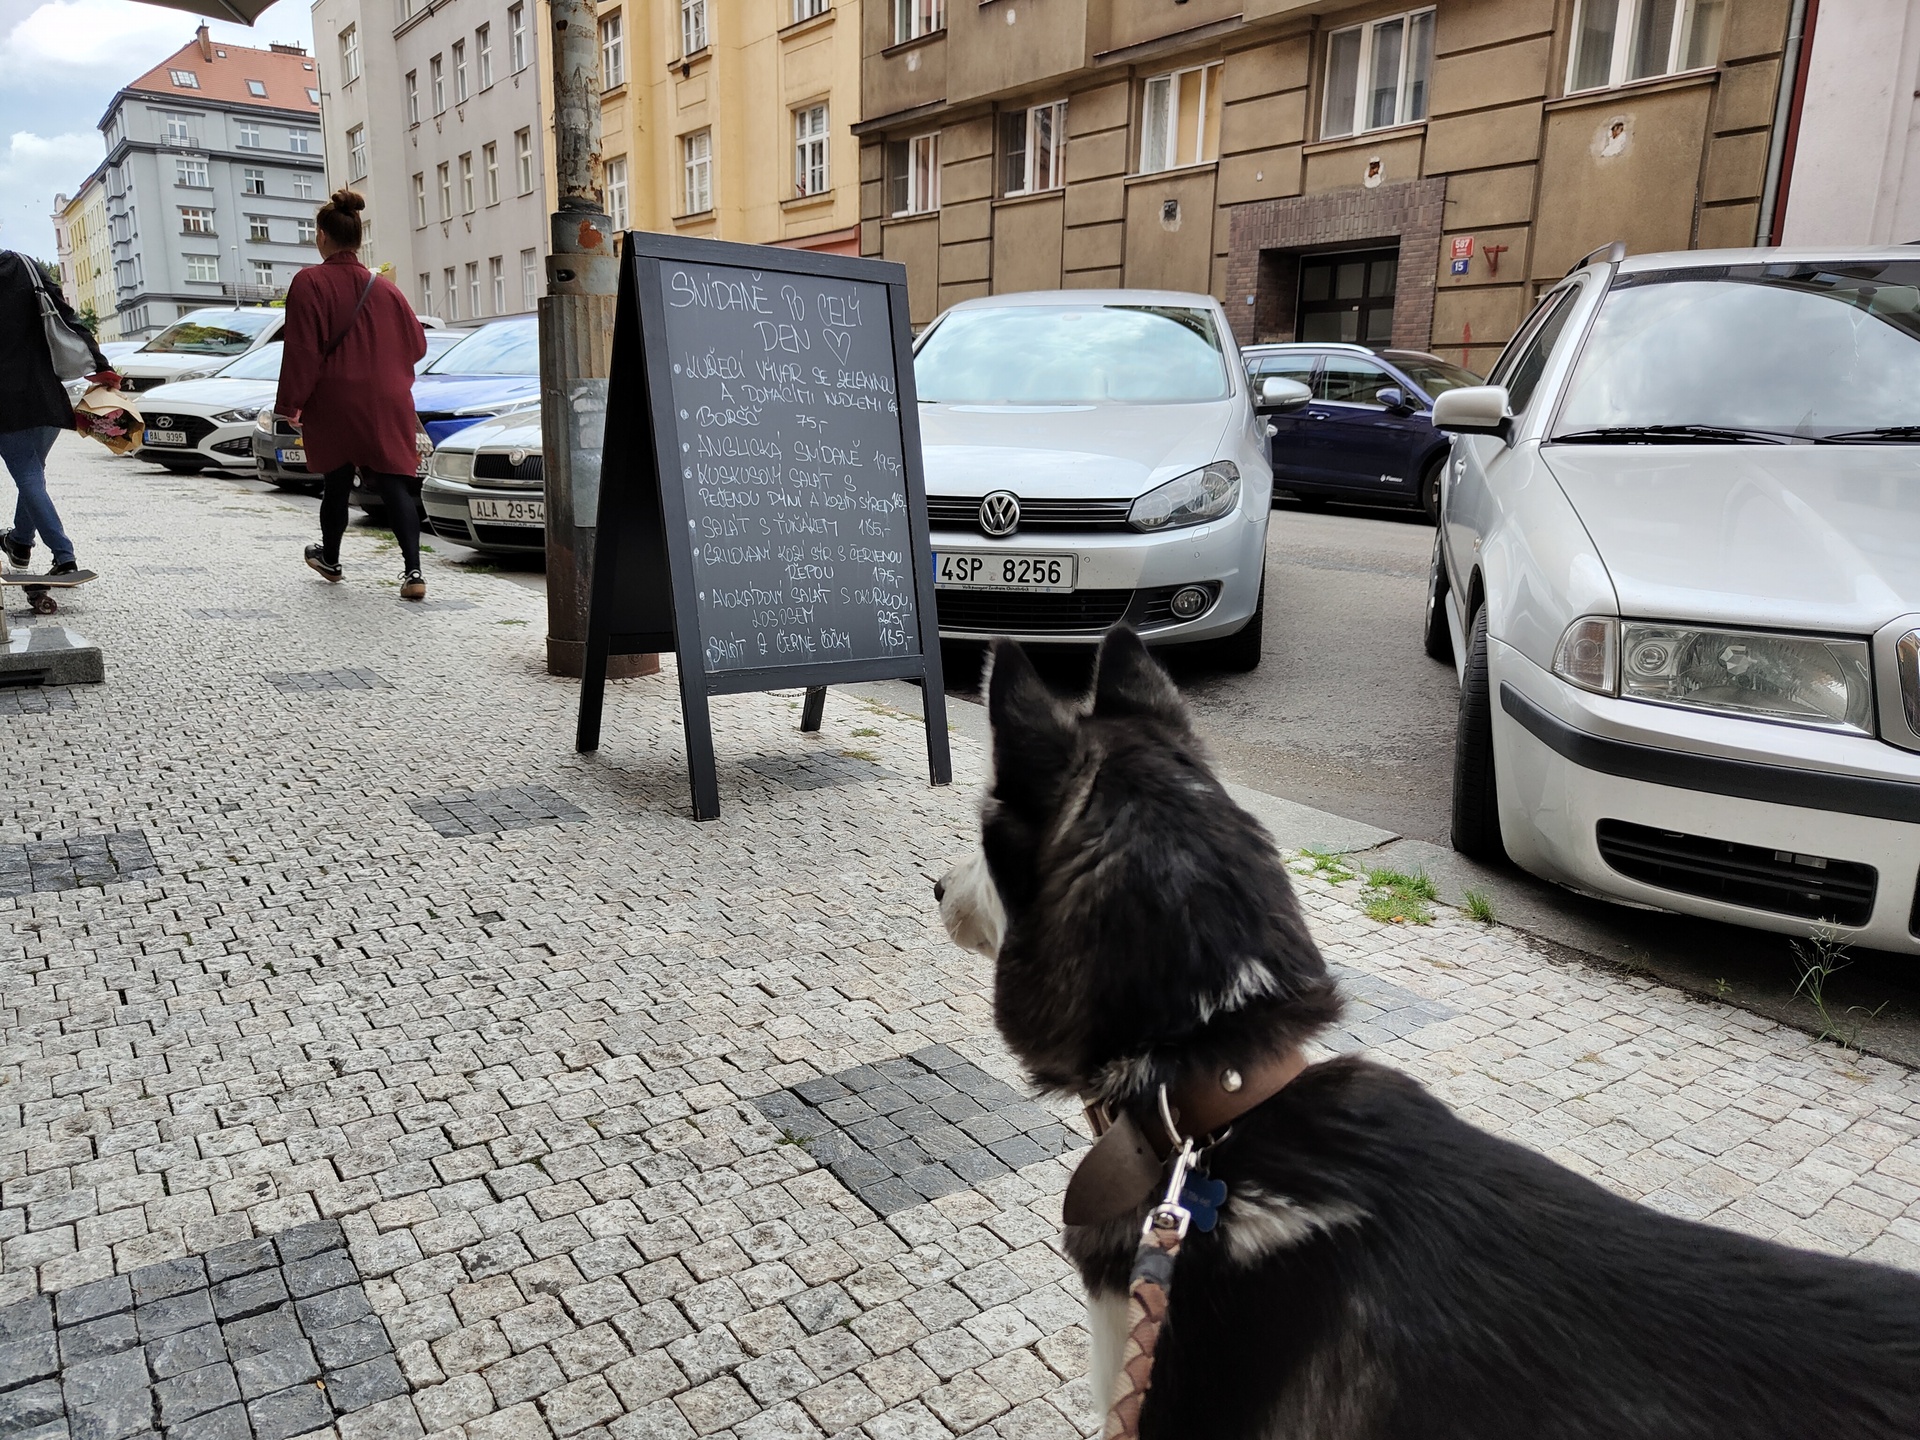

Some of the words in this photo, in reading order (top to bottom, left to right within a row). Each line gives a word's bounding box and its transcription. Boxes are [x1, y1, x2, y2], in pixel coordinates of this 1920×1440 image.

[1455, 239, 1471, 249] 587
[1455, 261, 1464, 271] 15
[670, 271, 773, 314] SNÍDANĚ
[817, 286, 863, 327] CELÝ
[753, 320, 811, 354] DEN
[812, 366, 831, 386] SE
[721, 382, 735, 404] A
[823, 391, 882, 412] NUDLEMI
[696, 405, 763, 427] BORŠČ
[166, 432, 184, 442] 9395
[697, 430, 782, 460] ANGLICKÁ
[794, 439, 863, 466] SNÍDANĚ
[844, 474, 857, 492] S
[476, 501, 499, 518] ALA
[809, 492, 819, 507] A
[702, 513, 750, 538] SALÁT
[760, 517, 771, 535] S
[838, 545, 847, 562] S
[785, 562, 834, 580] ŘEPOU
[942, 557, 983, 581] 4SP
[1003, 559, 1061, 584] 8256
[791, 583, 831, 604] SALÁT
[840, 587, 850, 604] S
[757, 632, 768, 655] Z
[777, 628, 816, 653] ČERNÉ
